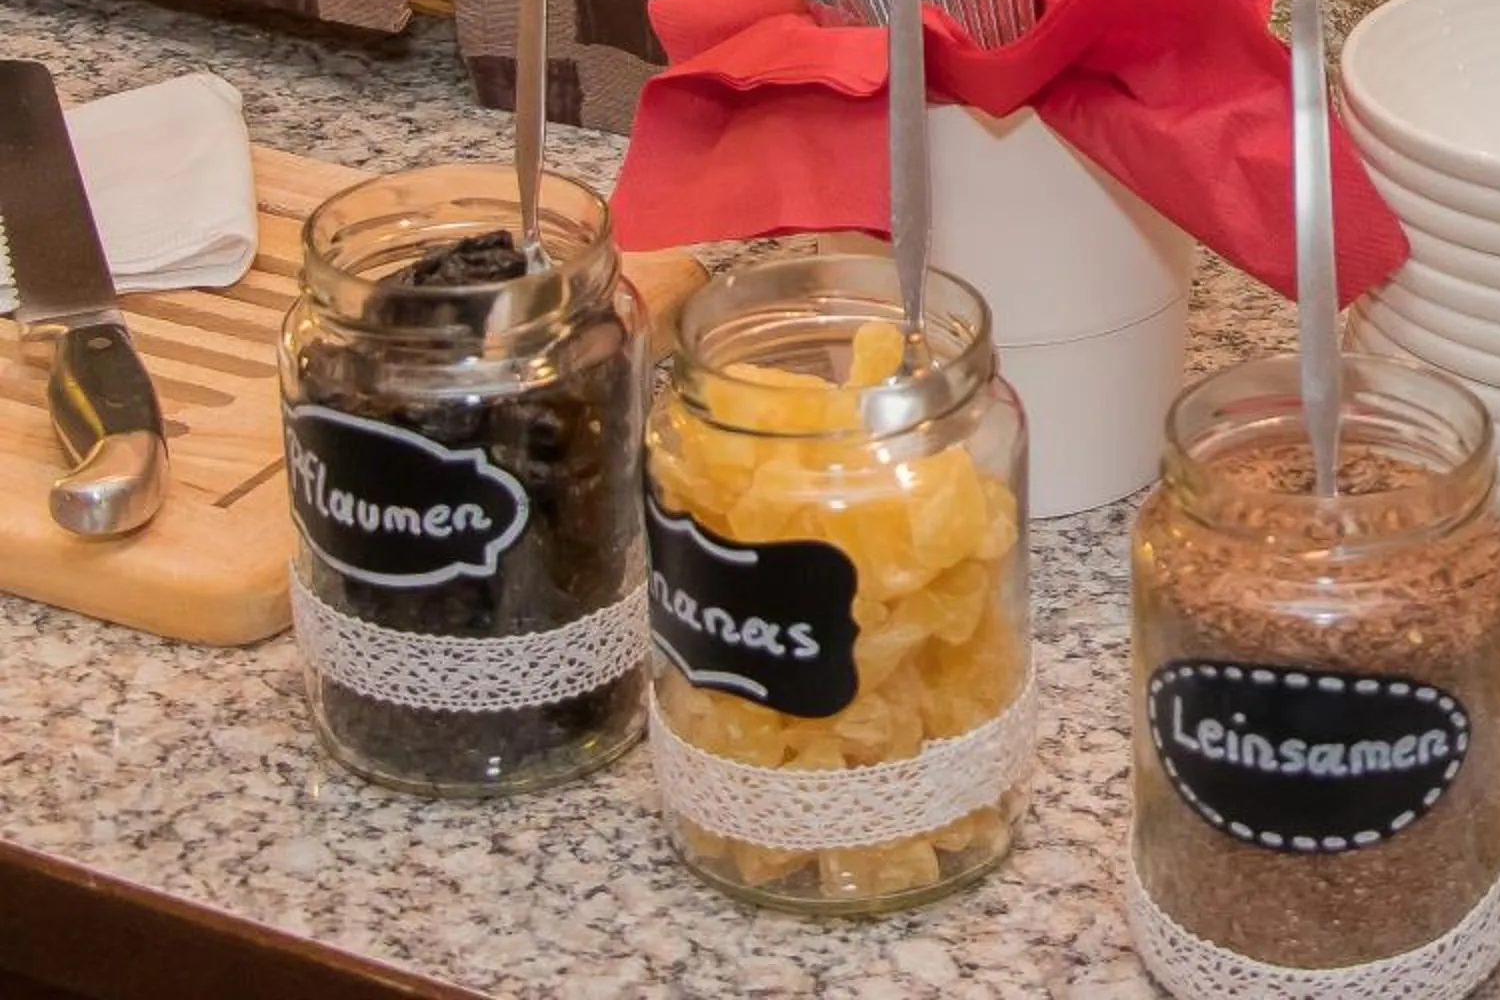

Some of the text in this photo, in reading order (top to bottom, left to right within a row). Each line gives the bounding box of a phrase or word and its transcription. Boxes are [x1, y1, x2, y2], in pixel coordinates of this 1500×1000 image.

[287, 426, 492, 538] Pflaumen
[651, 570, 820, 658] nanas
[1173, 695, 1448, 775] Leinsamen
